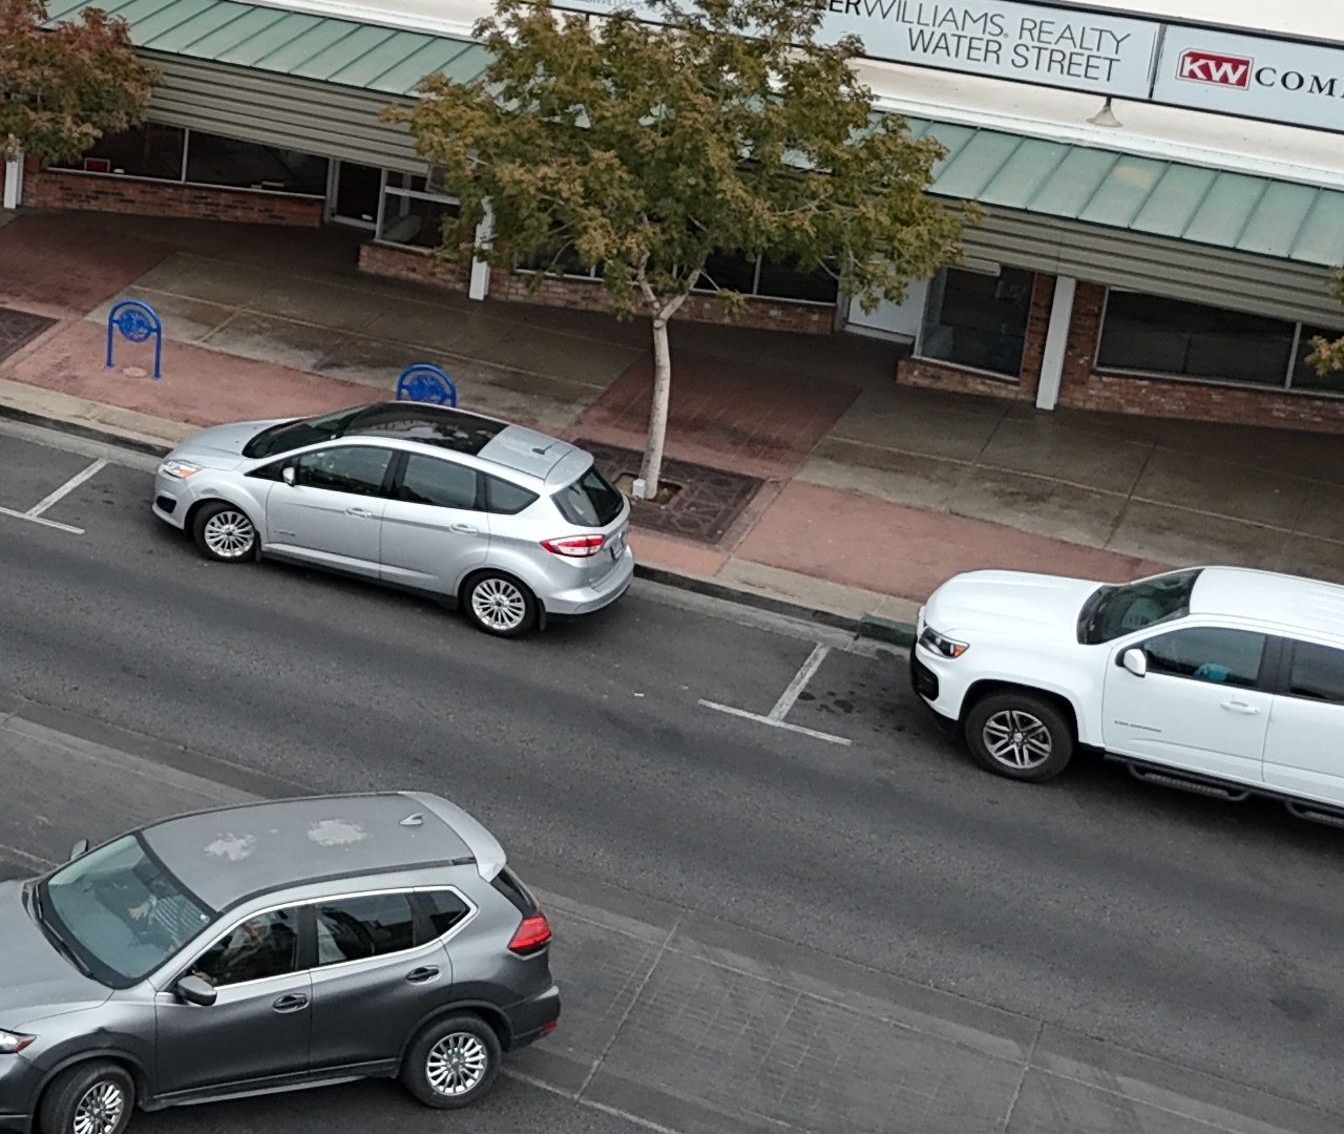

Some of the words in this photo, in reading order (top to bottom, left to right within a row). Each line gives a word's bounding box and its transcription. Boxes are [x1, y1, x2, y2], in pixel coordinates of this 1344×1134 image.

[908, 27, 1003, 65] WATER
[1011, 43, 1121, 83] STREET
[1018, 18, 1132, 55] REALTY
[1181, 56, 1248, 85] KW
[1255, 67, 1344, 100] COM
